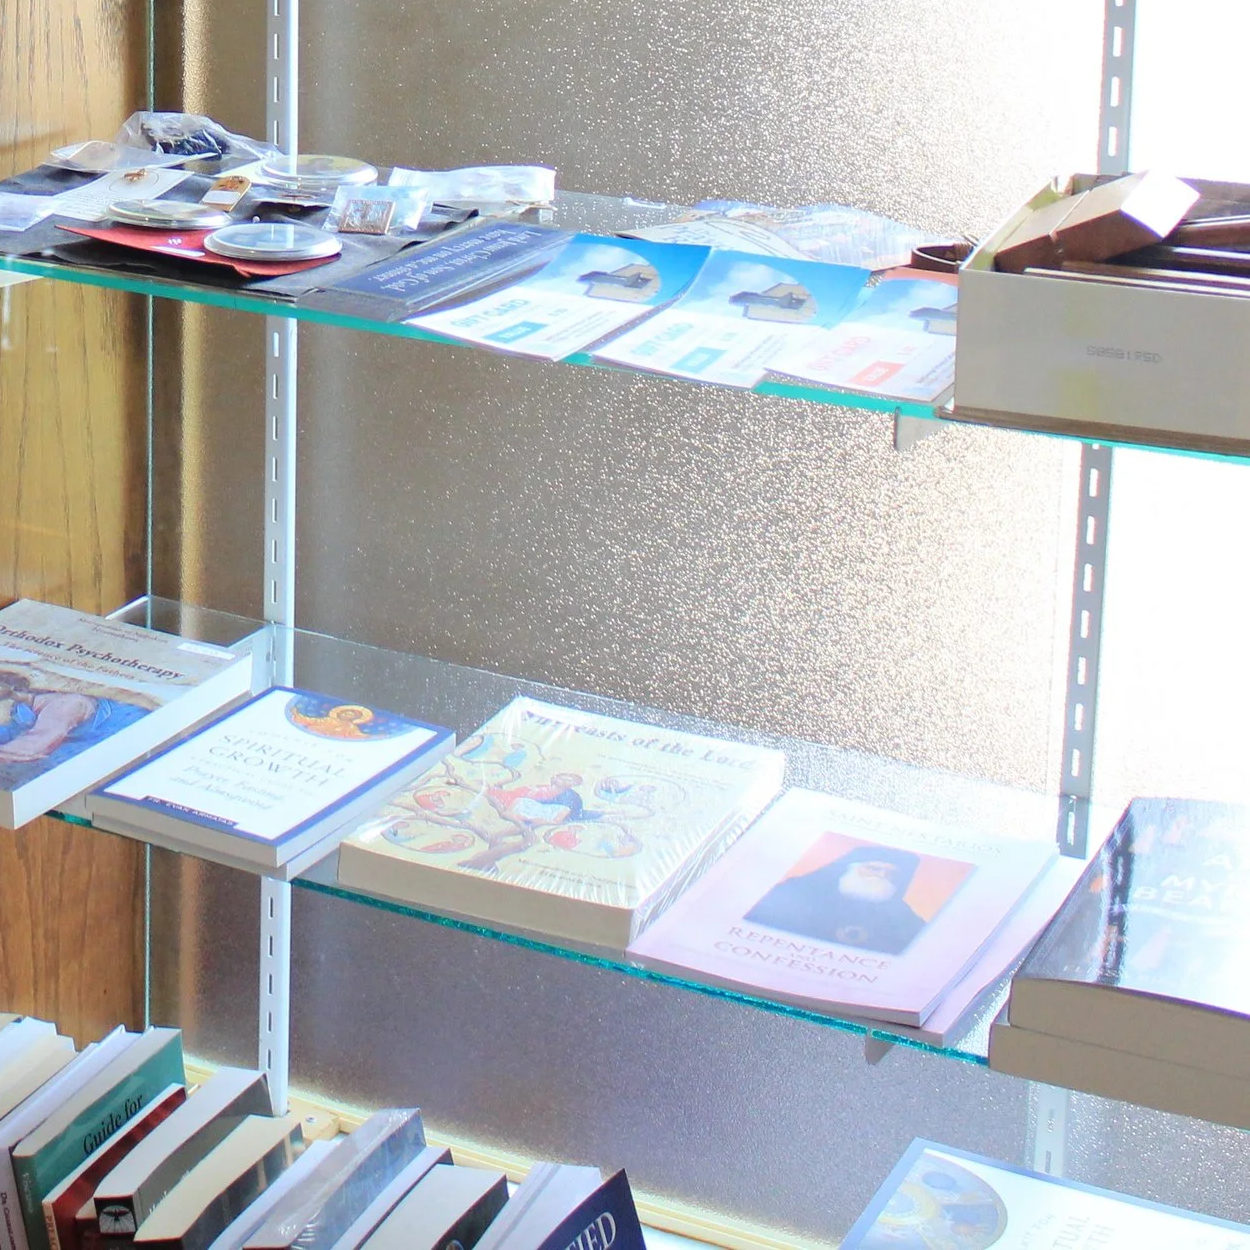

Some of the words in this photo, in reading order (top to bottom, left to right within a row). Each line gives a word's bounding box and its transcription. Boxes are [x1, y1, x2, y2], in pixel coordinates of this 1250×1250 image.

[65, 642, 185, 680] Psychotherapy
[208, 746, 328, 787] GROWTH
[221, 734, 345, 778] SPIRITUAL
[629, 737, 660, 751] of
[659, 742, 695, 757] the
[698, 748, 756, 770] Lord
[712, 940, 878, 983] CONFESSION
[727, 925, 892, 972] REPENTANCE
[83, 1110, 121, 1156] Guide
[123, 1093, 144, 1122] for
